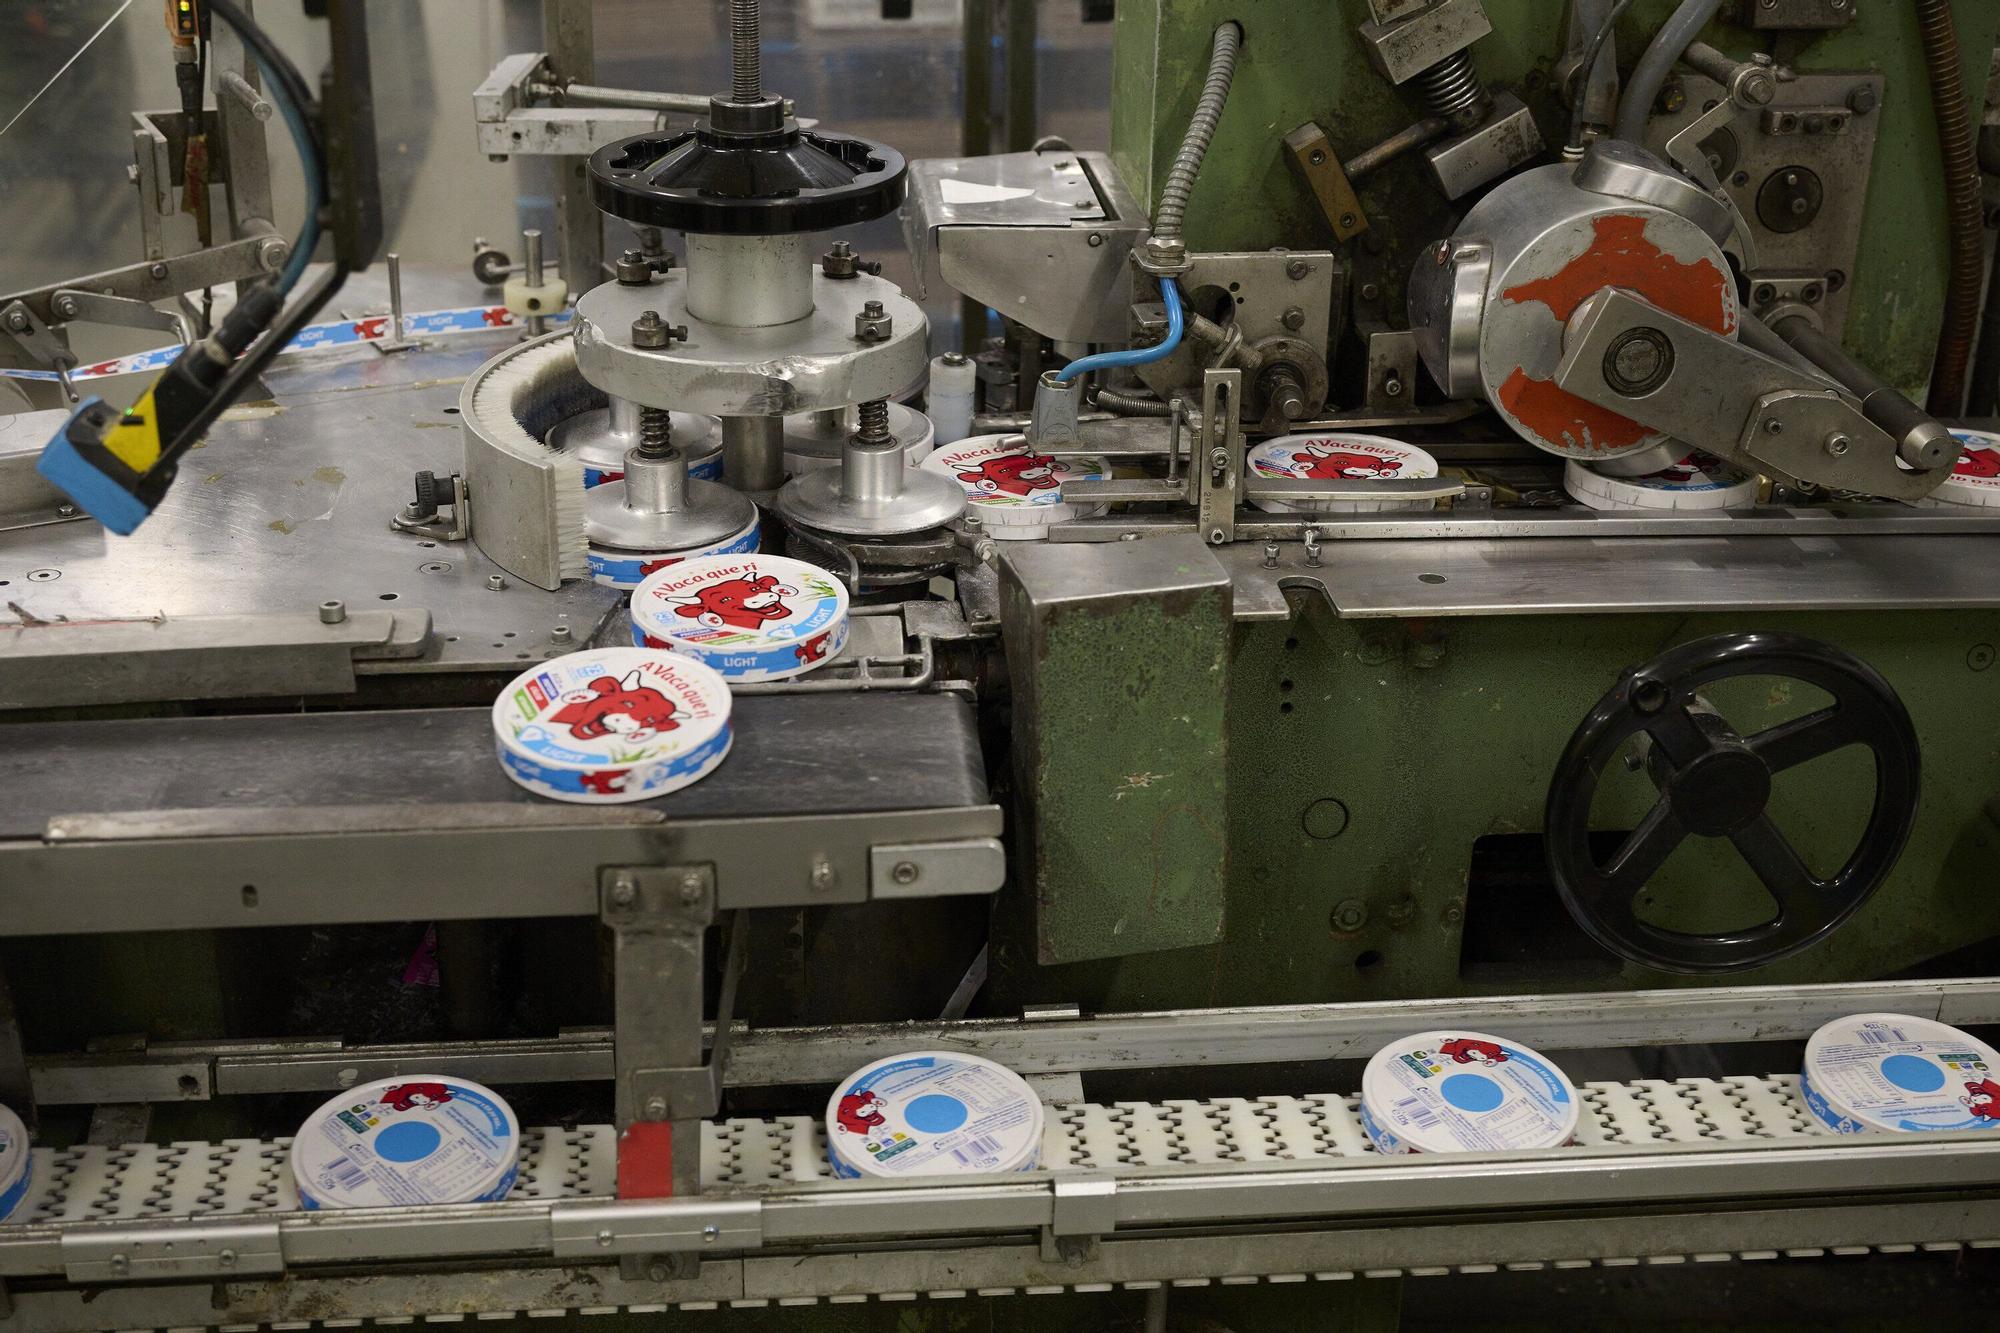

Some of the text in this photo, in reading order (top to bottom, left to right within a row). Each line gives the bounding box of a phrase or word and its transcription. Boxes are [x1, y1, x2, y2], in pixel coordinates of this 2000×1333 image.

[947, 449, 991, 462] Vaca
[1317, 440, 1361, 450] Vaca
[1363, 446, 1395, 454] que
[652, 562, 758, 599] A Vaca que ri
[805, 607, 832, 628] LIGHT
[724, 656, 758, 668] LIGHT
[638, 661, 655, 671] A
[654, 664, 690, 690] Vaca
[682, 690, 707, 709] que
